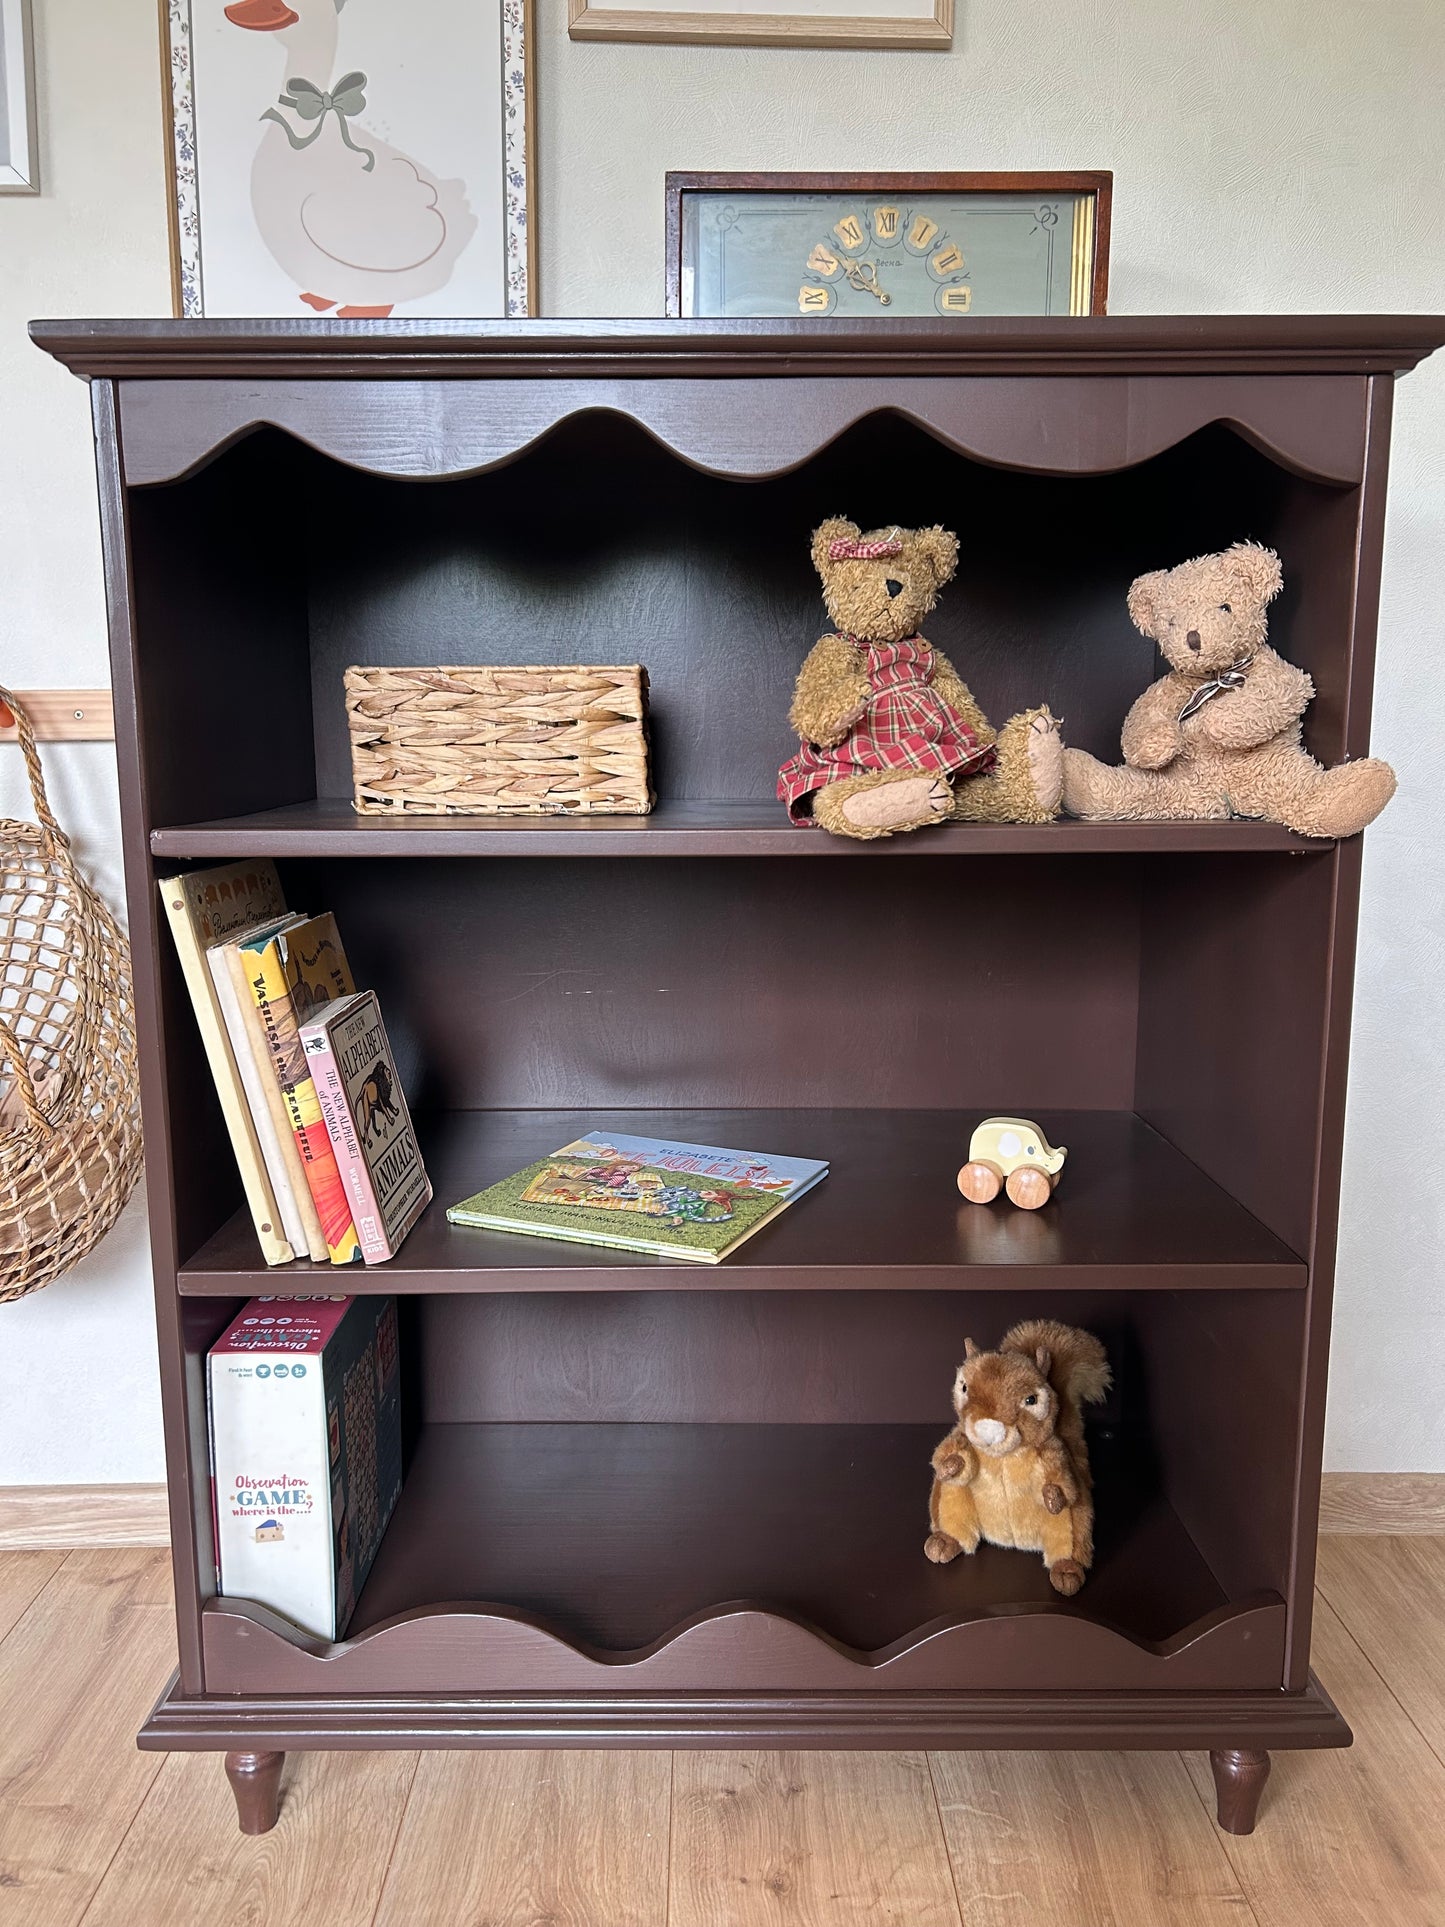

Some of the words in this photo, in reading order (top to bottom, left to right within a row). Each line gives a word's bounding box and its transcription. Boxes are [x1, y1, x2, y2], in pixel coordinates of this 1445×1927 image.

[841, 221, 861, 245] XI
[879, 212, 896, 233] XII
[917, 223, 930, 242] I
[814, 251, 835, 271] X
[938, 252, 958, 269] II
[804, 290, 824, 305] IX
[948, 293, 967, 305] III
[252, 973, 282, 1053] VASILISA
[341, 1024, 385, 1083] ALPHABET
[276, 1056, 288, 1081] the
[325, 1068, 339, 1089] THE
[318, 1090, 330, 1100] of
[332, 1091, 347, 1112] NEW
[281, 1080, 314, 1163] BEAUTIFUL
[321, 1101, 342, 1143] ANIMALS
[338, 1114, 361, 1159] ALPHABET
[659, 1148, 734, 1163] ELIZABETE
[375, 1131, 415, 1205] ANIMALS
[349, 1167, 365, 1206] WORMELL
[366, 1245, 384, 1254] KIDS
[235, 1473, 309, 1490] Observation
[236, 1489, 307, 1506] GAME
[231, 1506, 265, 1516] where
[266, 1505, 276, 1516] is
